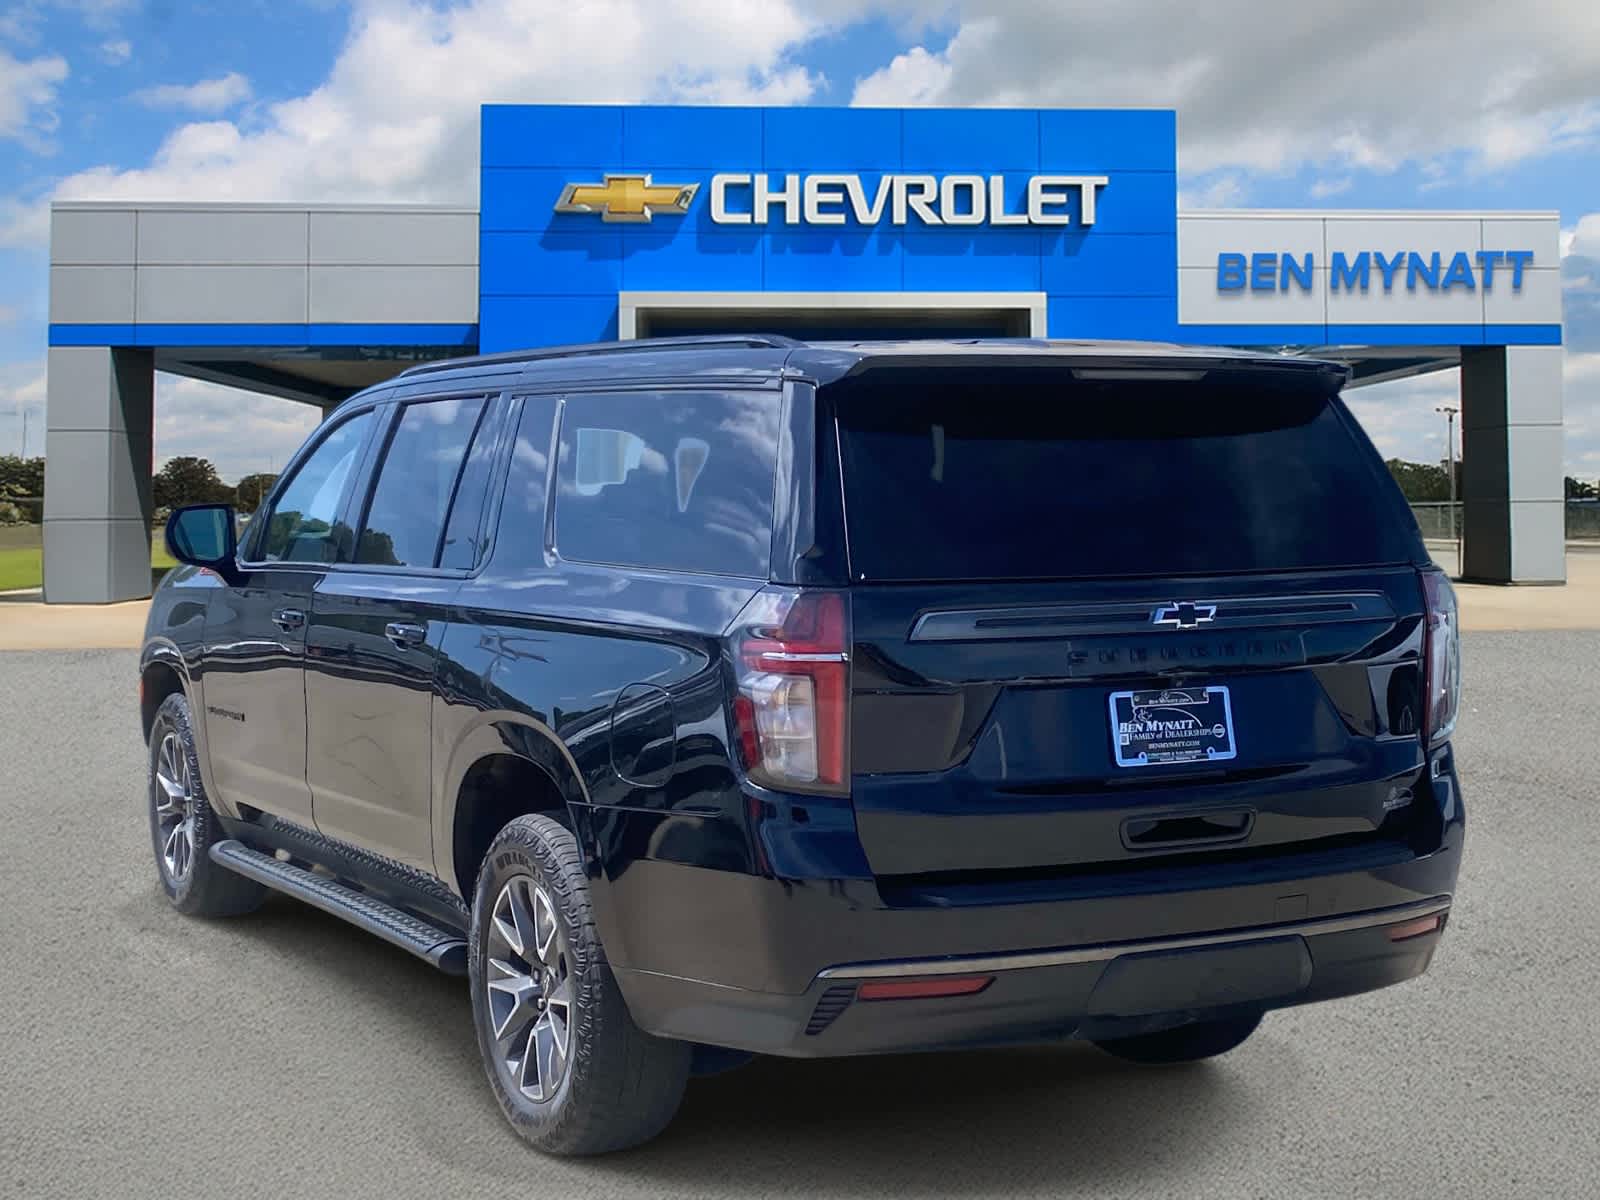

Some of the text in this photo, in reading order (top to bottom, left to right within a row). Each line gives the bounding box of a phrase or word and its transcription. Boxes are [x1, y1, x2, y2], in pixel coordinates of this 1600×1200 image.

[710, 173, 1109, 226] CHEVROLET
[1217, 250, 1534, 291] BEN MYNATT
[1119, 719, 1195, 733] BEN MYNATT
[1129, 732, 1157, 741] FAMILY
